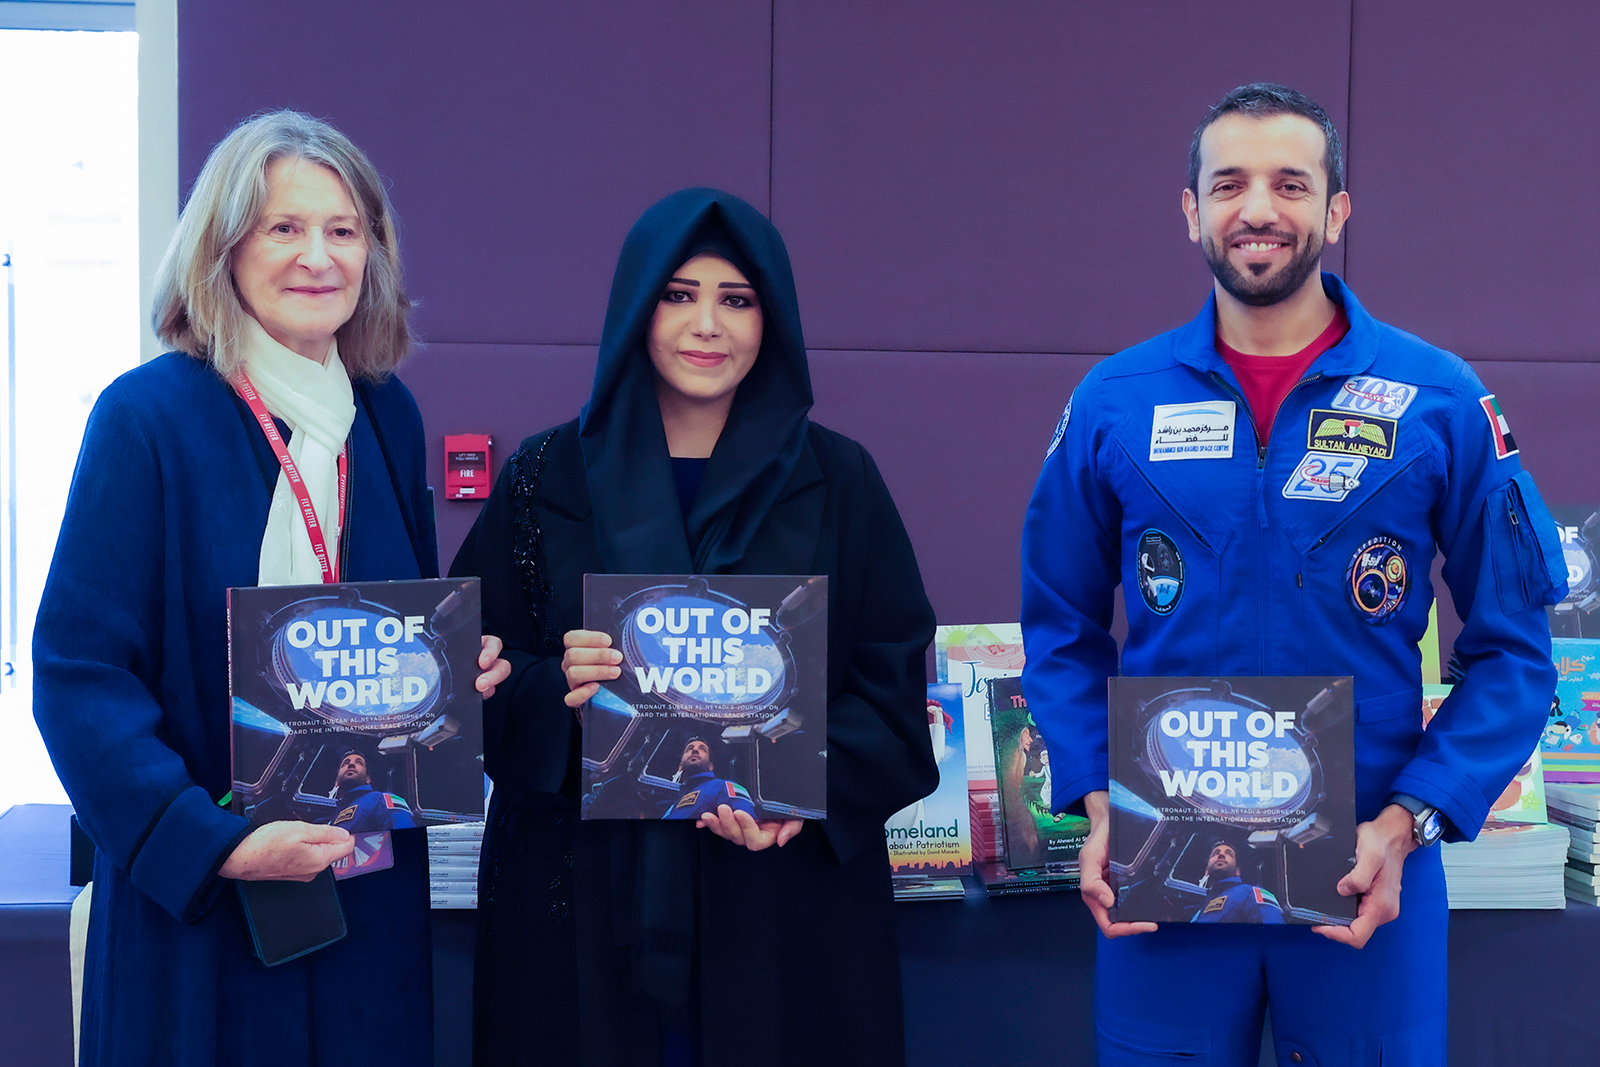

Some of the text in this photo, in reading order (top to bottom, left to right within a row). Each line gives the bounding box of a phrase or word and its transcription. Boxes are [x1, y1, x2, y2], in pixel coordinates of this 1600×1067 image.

[1364, 392, 1384, 402] DAYS
[259, 413, 279, 441] FLY BETTER
[1157, 425, 1172, 435] راشد
[1173, 426, 1182, 435] بن
[1200, 424, 1229, 433] مركز
[1314, 439, 1388, 457] SULTAN ALNEYADI
[281, 455, 300, 483] FLY BETTER
[1294, 458, 1354, 493] 25
[301, 498, 317, 529] FLY BETTER
[1353, 536, 1402, 559] EXPEDITION
[317, 553, 328, 573] BETTER
[287, 616, 425, 648] OUT OF
[636, 607, 771, 635] OUT OF
[314, 647, 399, 678] THIS
[662, 637, 744, 664] THIS
[286, 677, 428, 710] WORLD
[635, 667, 771, 694] WORLD
[279, 720, 320, 728] ASTRONAUT
[325, 724, 378, 733] INTERNATIONAL
[1160, 710, 1296, 738] OUT OF
[1186, 740, 1270, 768] THIS
[1159, 770, 1298, 798] WORLD
[889, 840, 959, 850] about Patriotism
